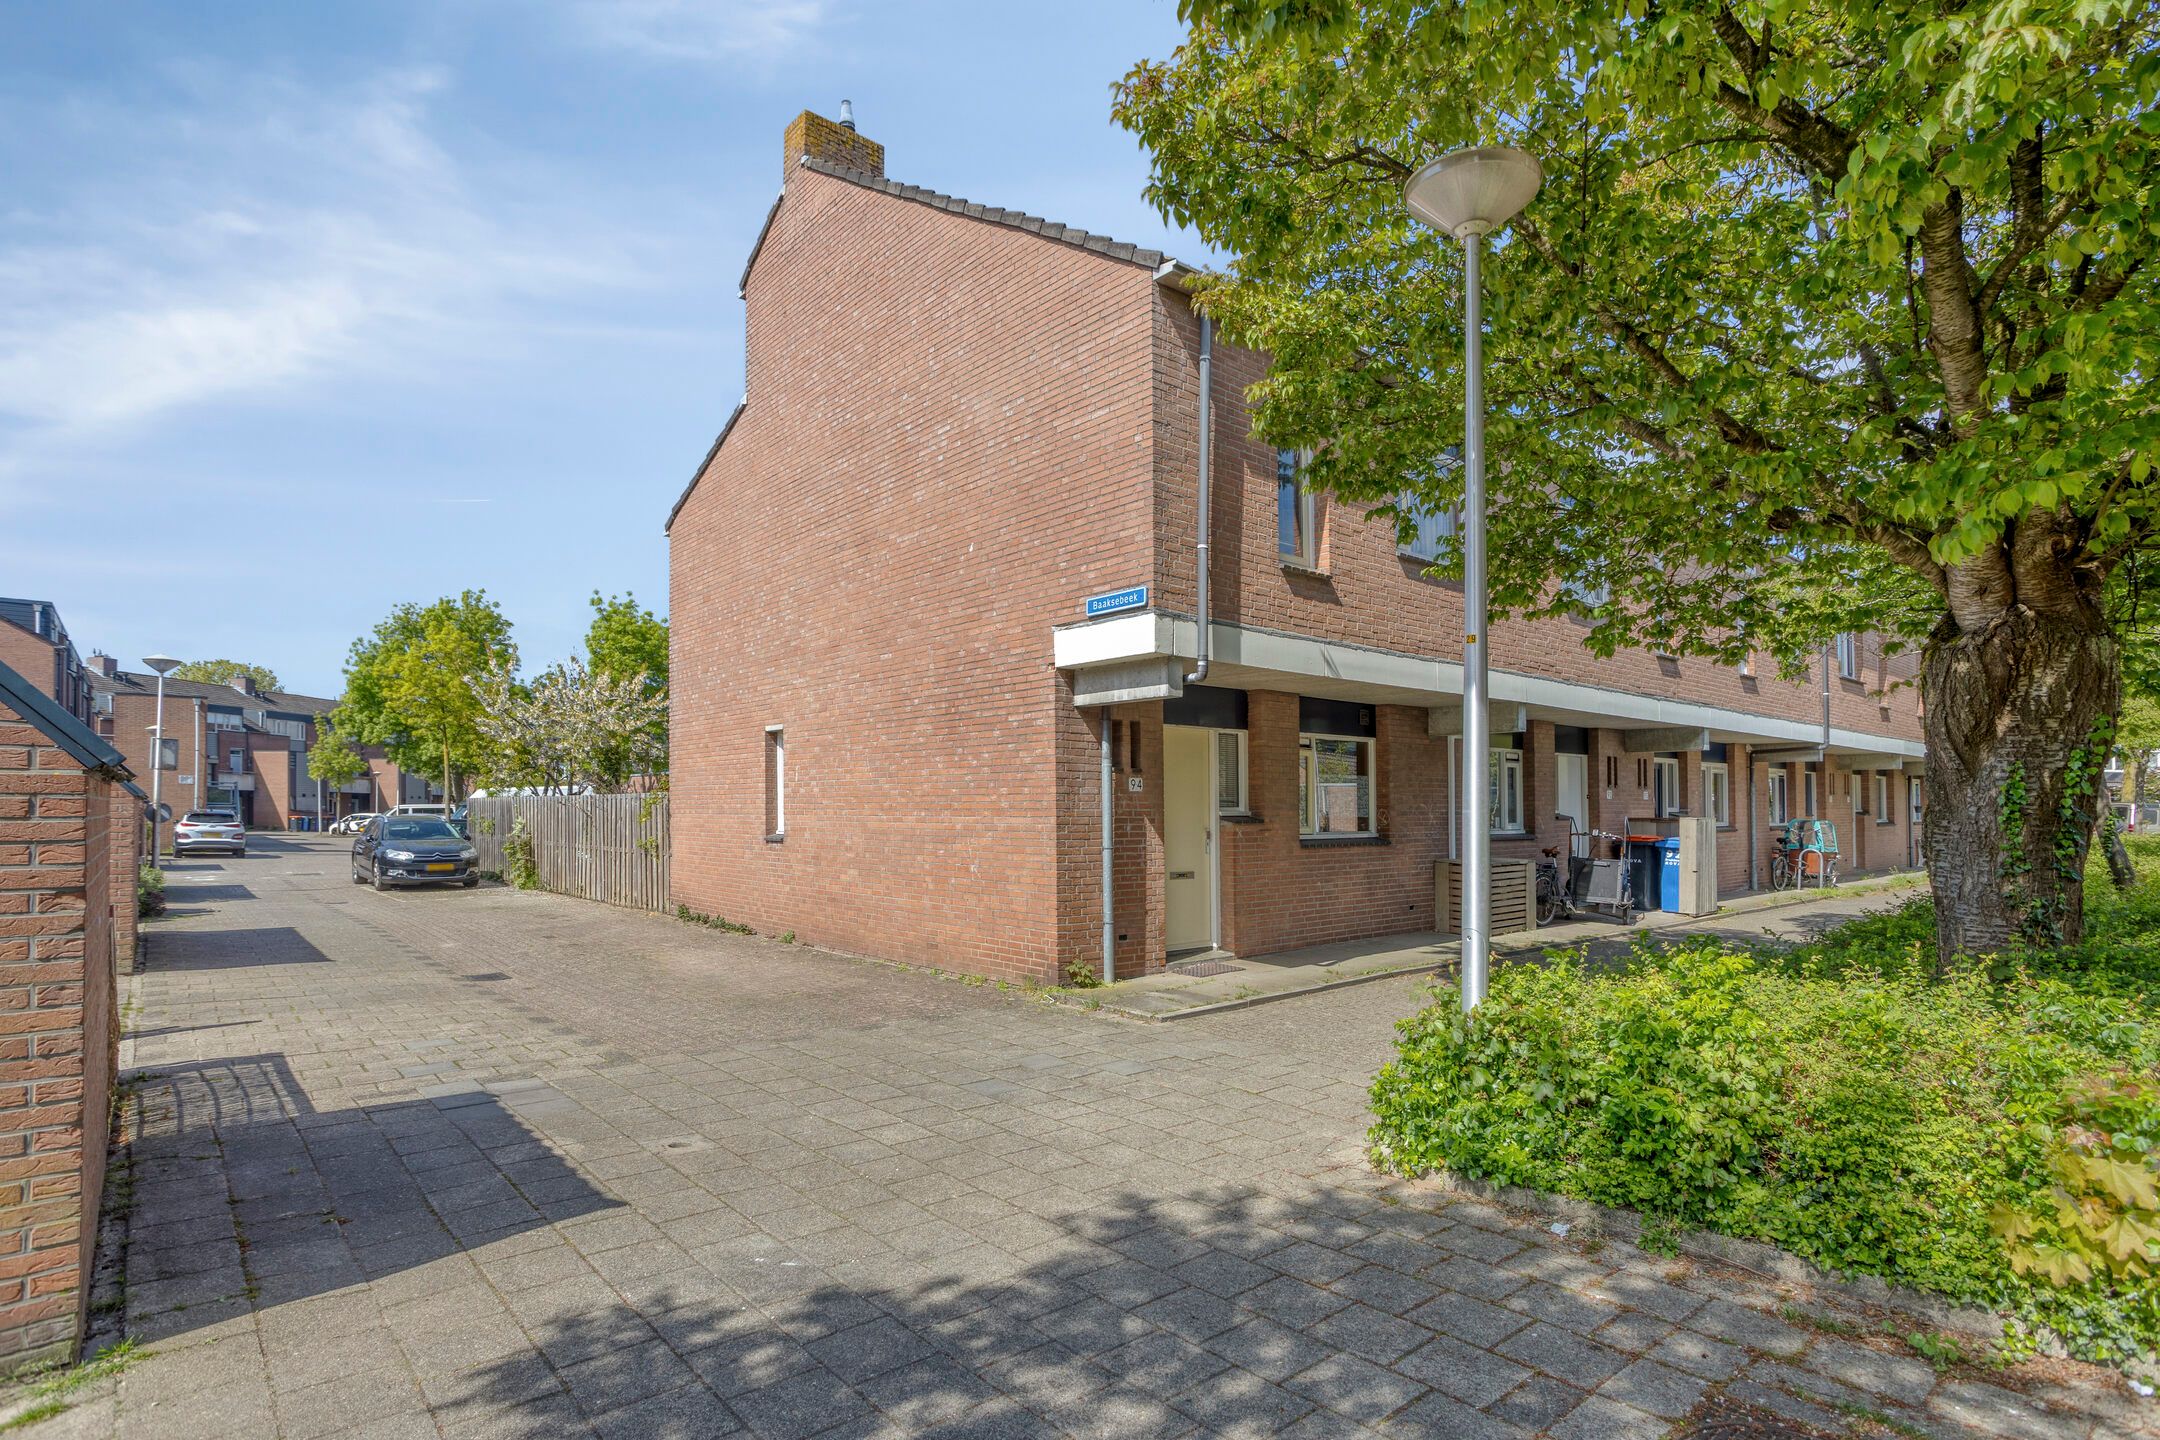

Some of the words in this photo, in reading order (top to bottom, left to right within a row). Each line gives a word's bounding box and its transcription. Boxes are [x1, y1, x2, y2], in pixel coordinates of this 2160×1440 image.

[1093, 593, 1138, 609] Baaksebeek
[1466, 634, 1476, 643] 29
[1131, 779, 1142, 790] 94
